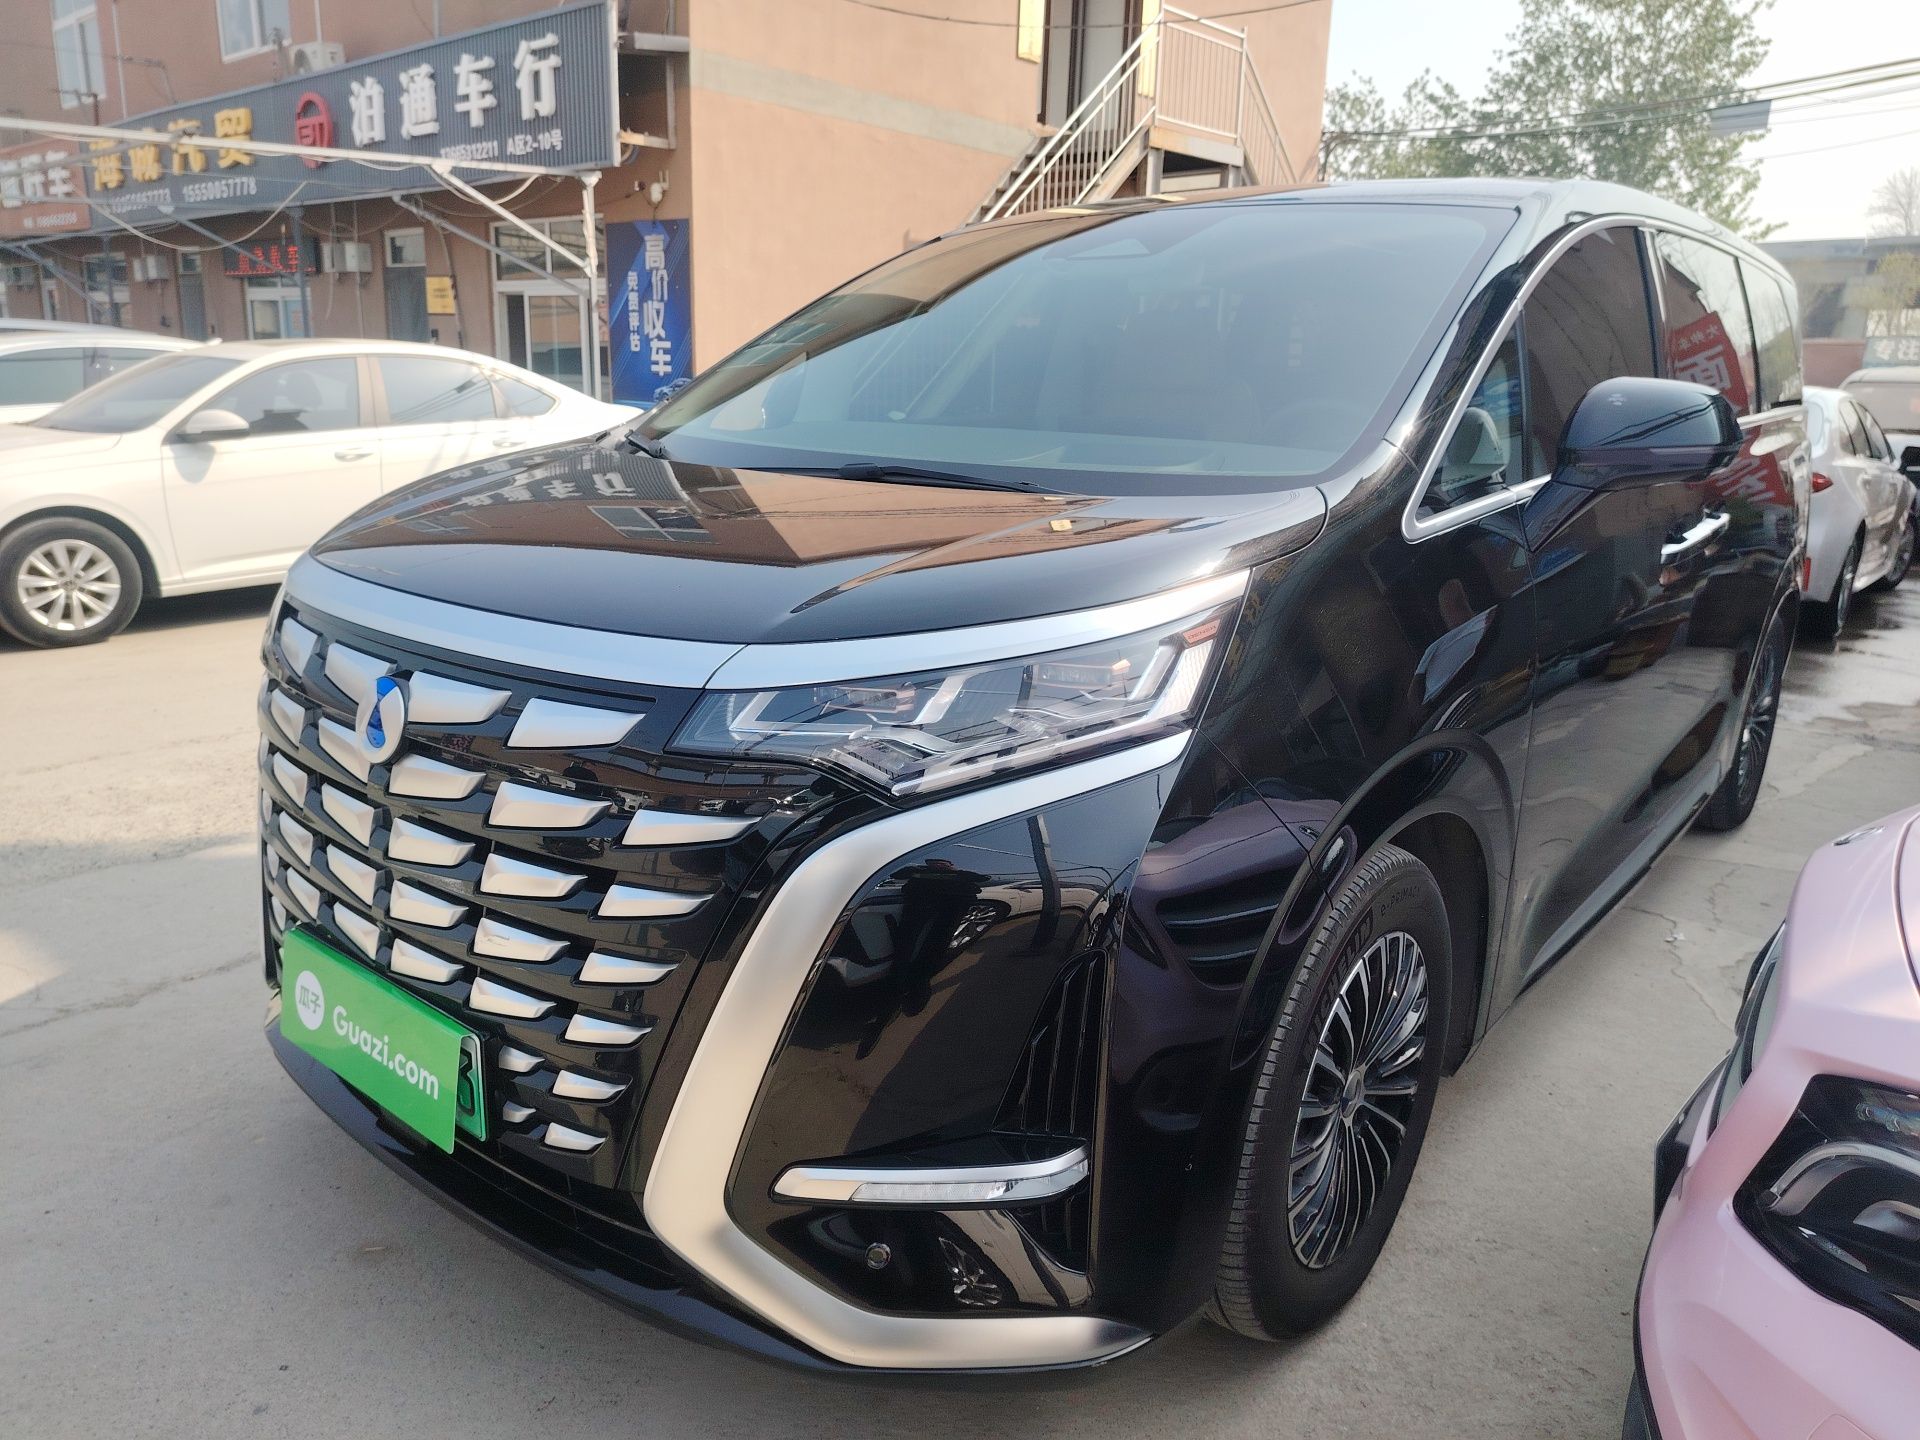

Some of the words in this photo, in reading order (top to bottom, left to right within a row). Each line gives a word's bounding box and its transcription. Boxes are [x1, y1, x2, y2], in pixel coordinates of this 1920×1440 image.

[349, 32, 563, 148] 泊通车行
[643, 234, 673, 377] 高价收车
[299, 984, 322, 1015] 瓜子
[333, 1005, 439, 1100] Guazi.com
